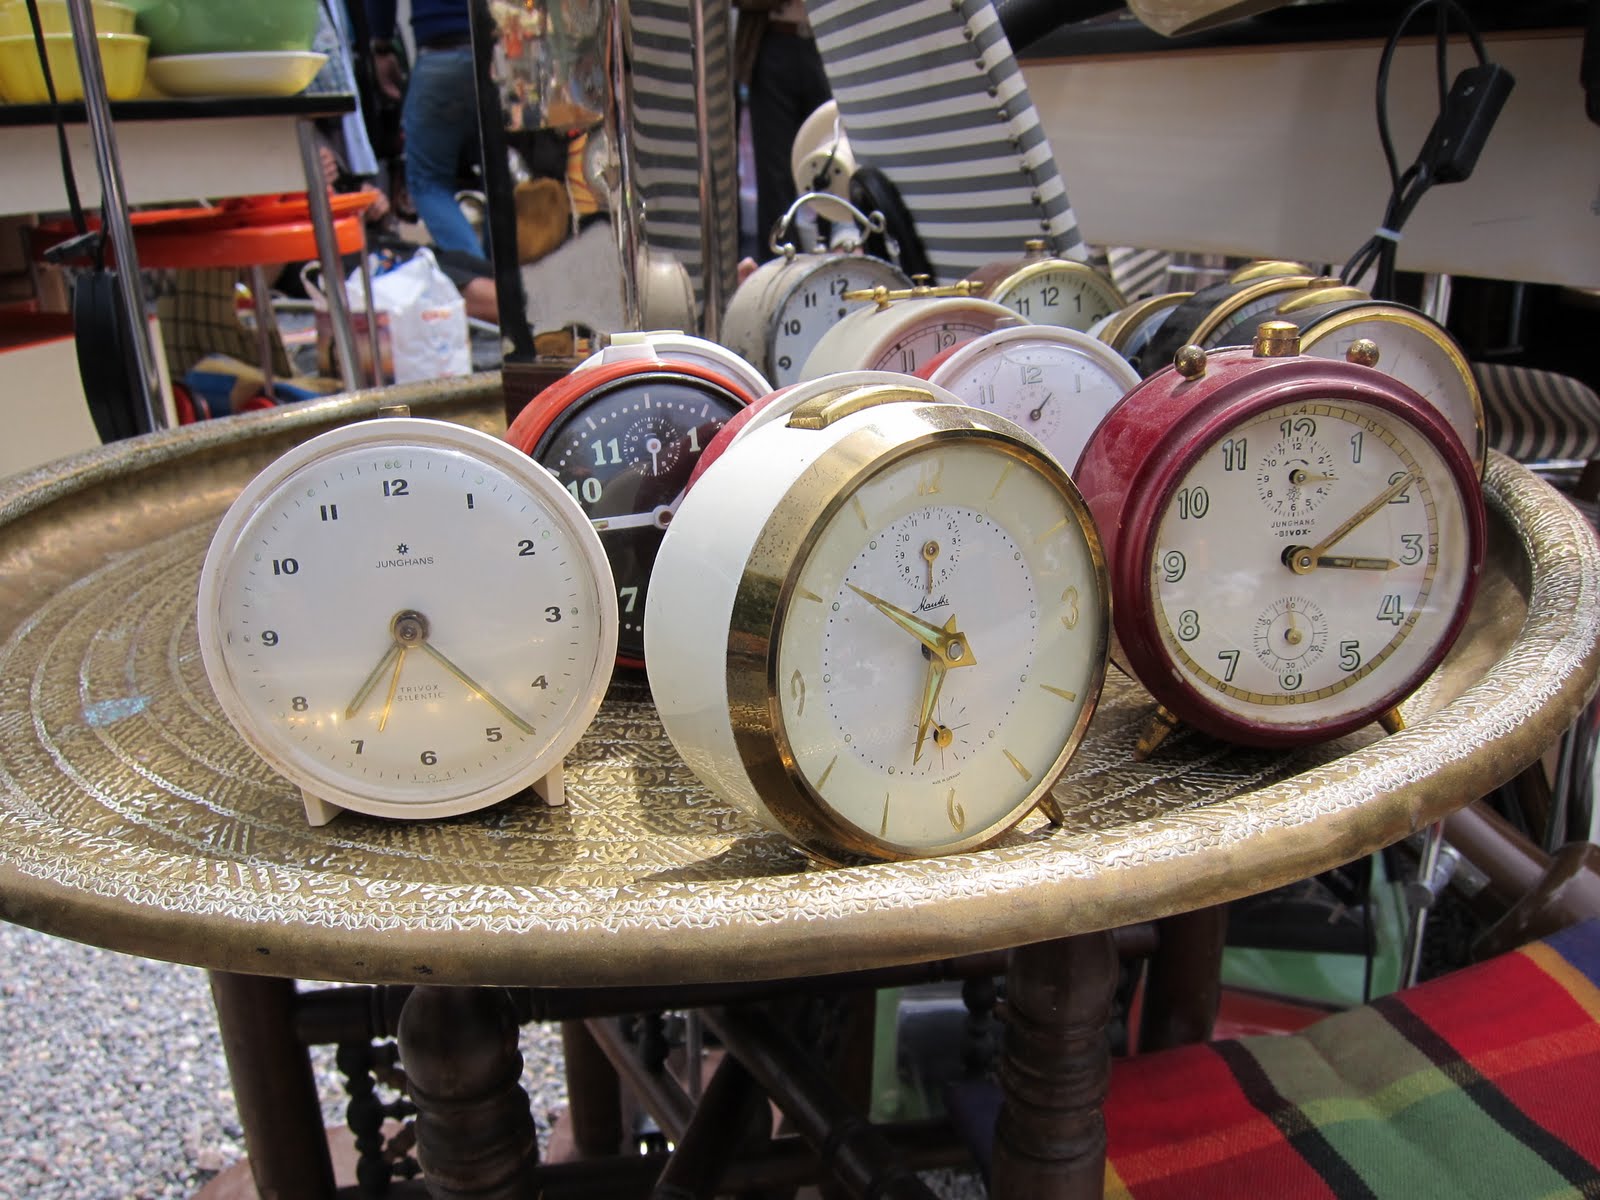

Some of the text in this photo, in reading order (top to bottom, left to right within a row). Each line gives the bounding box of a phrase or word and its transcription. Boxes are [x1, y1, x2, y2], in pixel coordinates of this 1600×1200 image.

[830, 278, 849, 296] 12
[805, 292, 817, 308] 11
[1041, 286, 1059, 306] 12
[1074, 293, 1082, 312] 1
[1016, 298, 1029, 316] 11
[784, 319, 801, 336] 10
[778, 356, 792, 370] 9
[1021, 366, 1042, 385] 12
[979, 384, 994, 405] 11
[1364, 419, 1378, 433] 13
[687, 426, 701, 453] 1
[1292, 443, 1302, 451] 12
[1351, 431, 1363, 463] 1
[591, 438, 623, 466] 11
[1222, 438, 1247, 471] 11
[1318, 456, 1325, 465] 2
[1263, 475, 1270, 483] 9
[383, 479, 410, 497] 12
[568, 477, 602, 505] 10
[1266, 490, 1273, 498] 8
[1316, 487, 1323, 495] 4
[1387, 472, 1411, 504] 2
[466, 493, 475, 510] 1
[1178, 486, 1209, 519] 10
[1277, 500, 1283, 508] 7
[1290, 504, 1297, 512] 6
[1305, 499, 1312, 507] 5
[320, 504, 338, 522] 11
[923, 512, 931, 520] 12
[911, 519, 918, 527] 11
[947, 522, 953, 530] 2
[1271, 519, 1316, 529] JUNGHANS
[902, 534, 910, 542] 10
[952, 537, 957, 545] 3
[517, 539, 536, 557] 2
[1400, 534, 1423, 566] 3
[273, 558, 299, 576] 10
[375, 556, 435, 569] JUNGHANS
[1163, 550, 1186, 583] 9
[619, 586, 638, 613] 7
[1061, 585, 1079, 630] 3
[544, 606, 563, 623] 3
[1376, 594, 1404, 626] 4
[1178, 609, 1200, 642] 8
[261, 630, 279, 647] 9
[1338, 640, 1361, 672] 5
[1218, 649, 1240, 682] 7
[400, 684, 439, 693] TRIVOX
[530, 674, 549, 691] 4
[1216, 680, 1228, 693] 19
[291, 696, 309, 713] 8
[397, 692, 443, 702] SILENTIC
[485, 727, 503, 744] 5
[350, 739, 365, 755] 7
[420, 750, 438, 766] 6
[945, 787, 965, 834] 6
